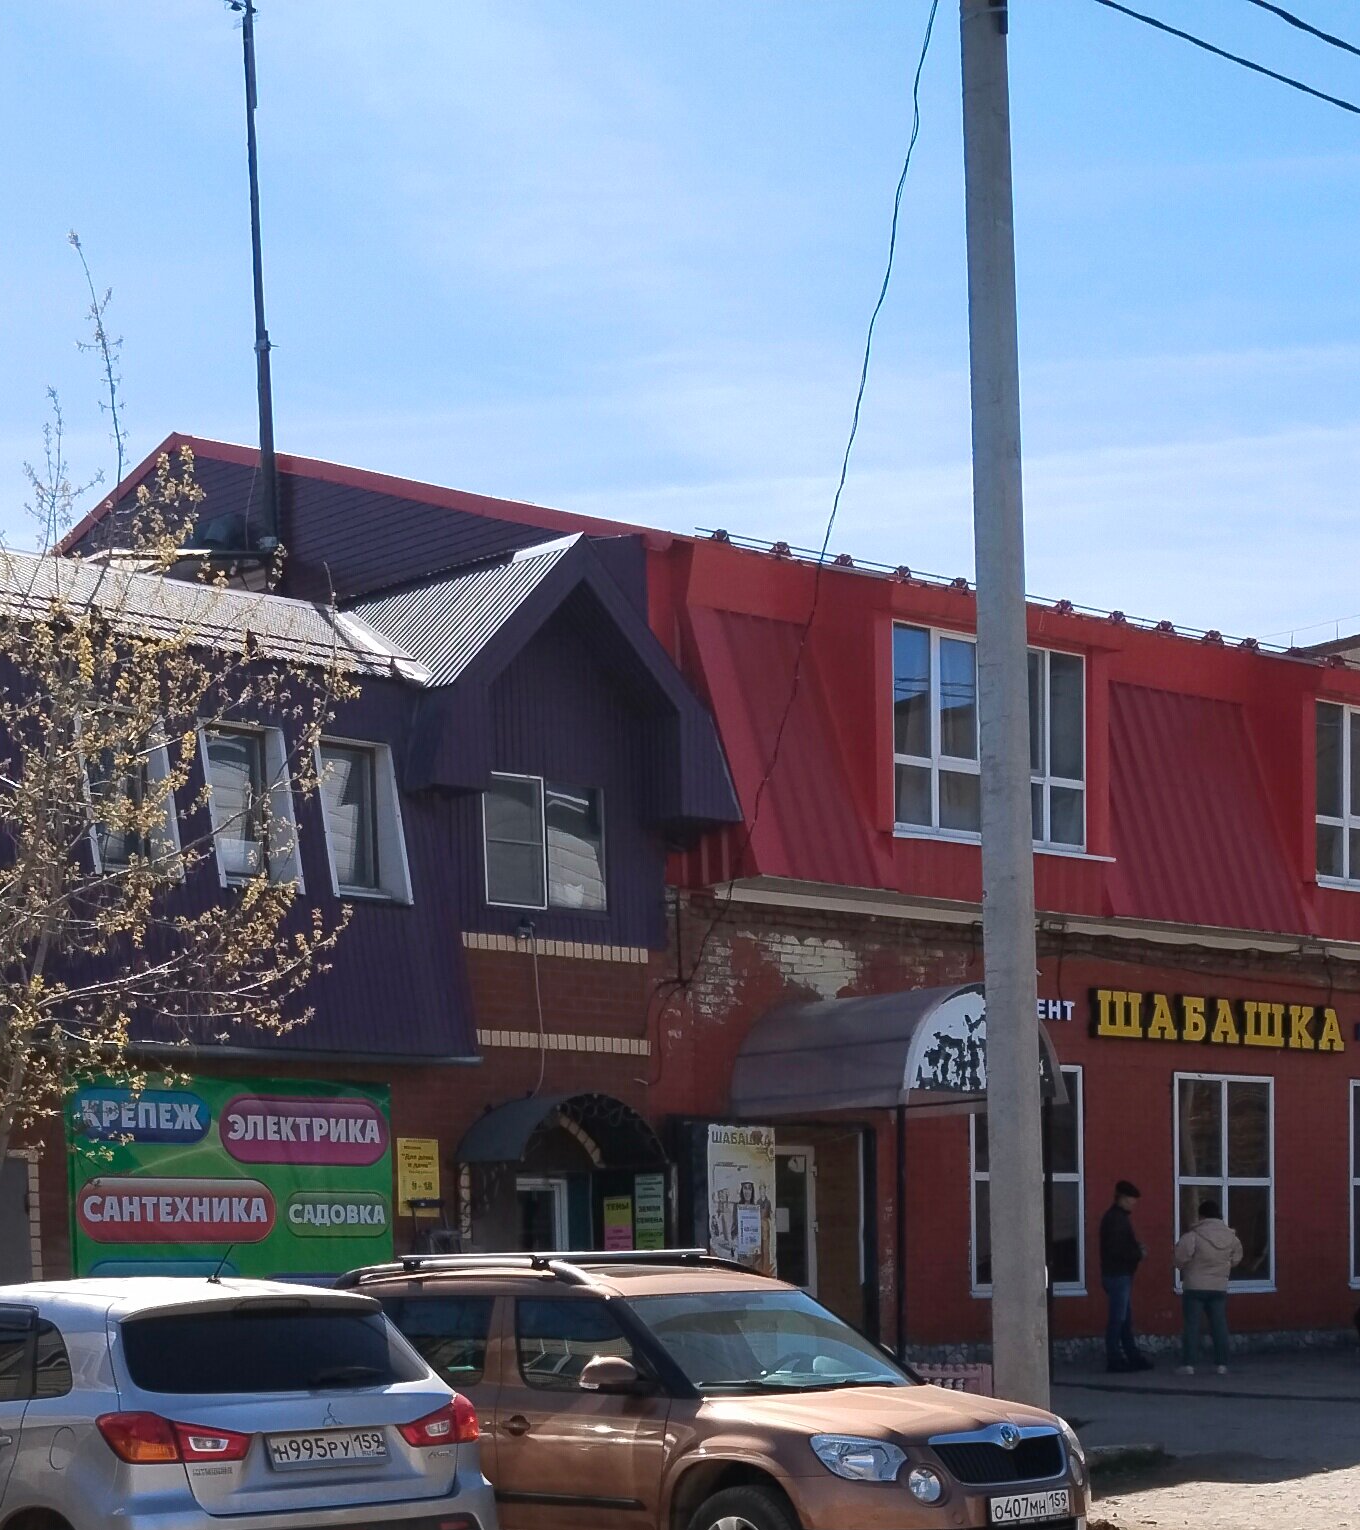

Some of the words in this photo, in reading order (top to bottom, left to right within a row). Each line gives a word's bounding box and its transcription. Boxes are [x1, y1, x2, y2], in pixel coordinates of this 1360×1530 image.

[1096, 989, 1345, 1052] ШАБАШКА
[80, 1099, 203, 1130] КРЕПЕЖ
[227, 1113, 382, 1144] ЭЛЕКТРИКА
[83, 1195, 268, 1223] САНТЕХНИКА
[288, 1203, 386, 1226] САДОВКА
[354, 1433, 381, 1450] 159
[1049, 1492, 1067, 1509] 159
